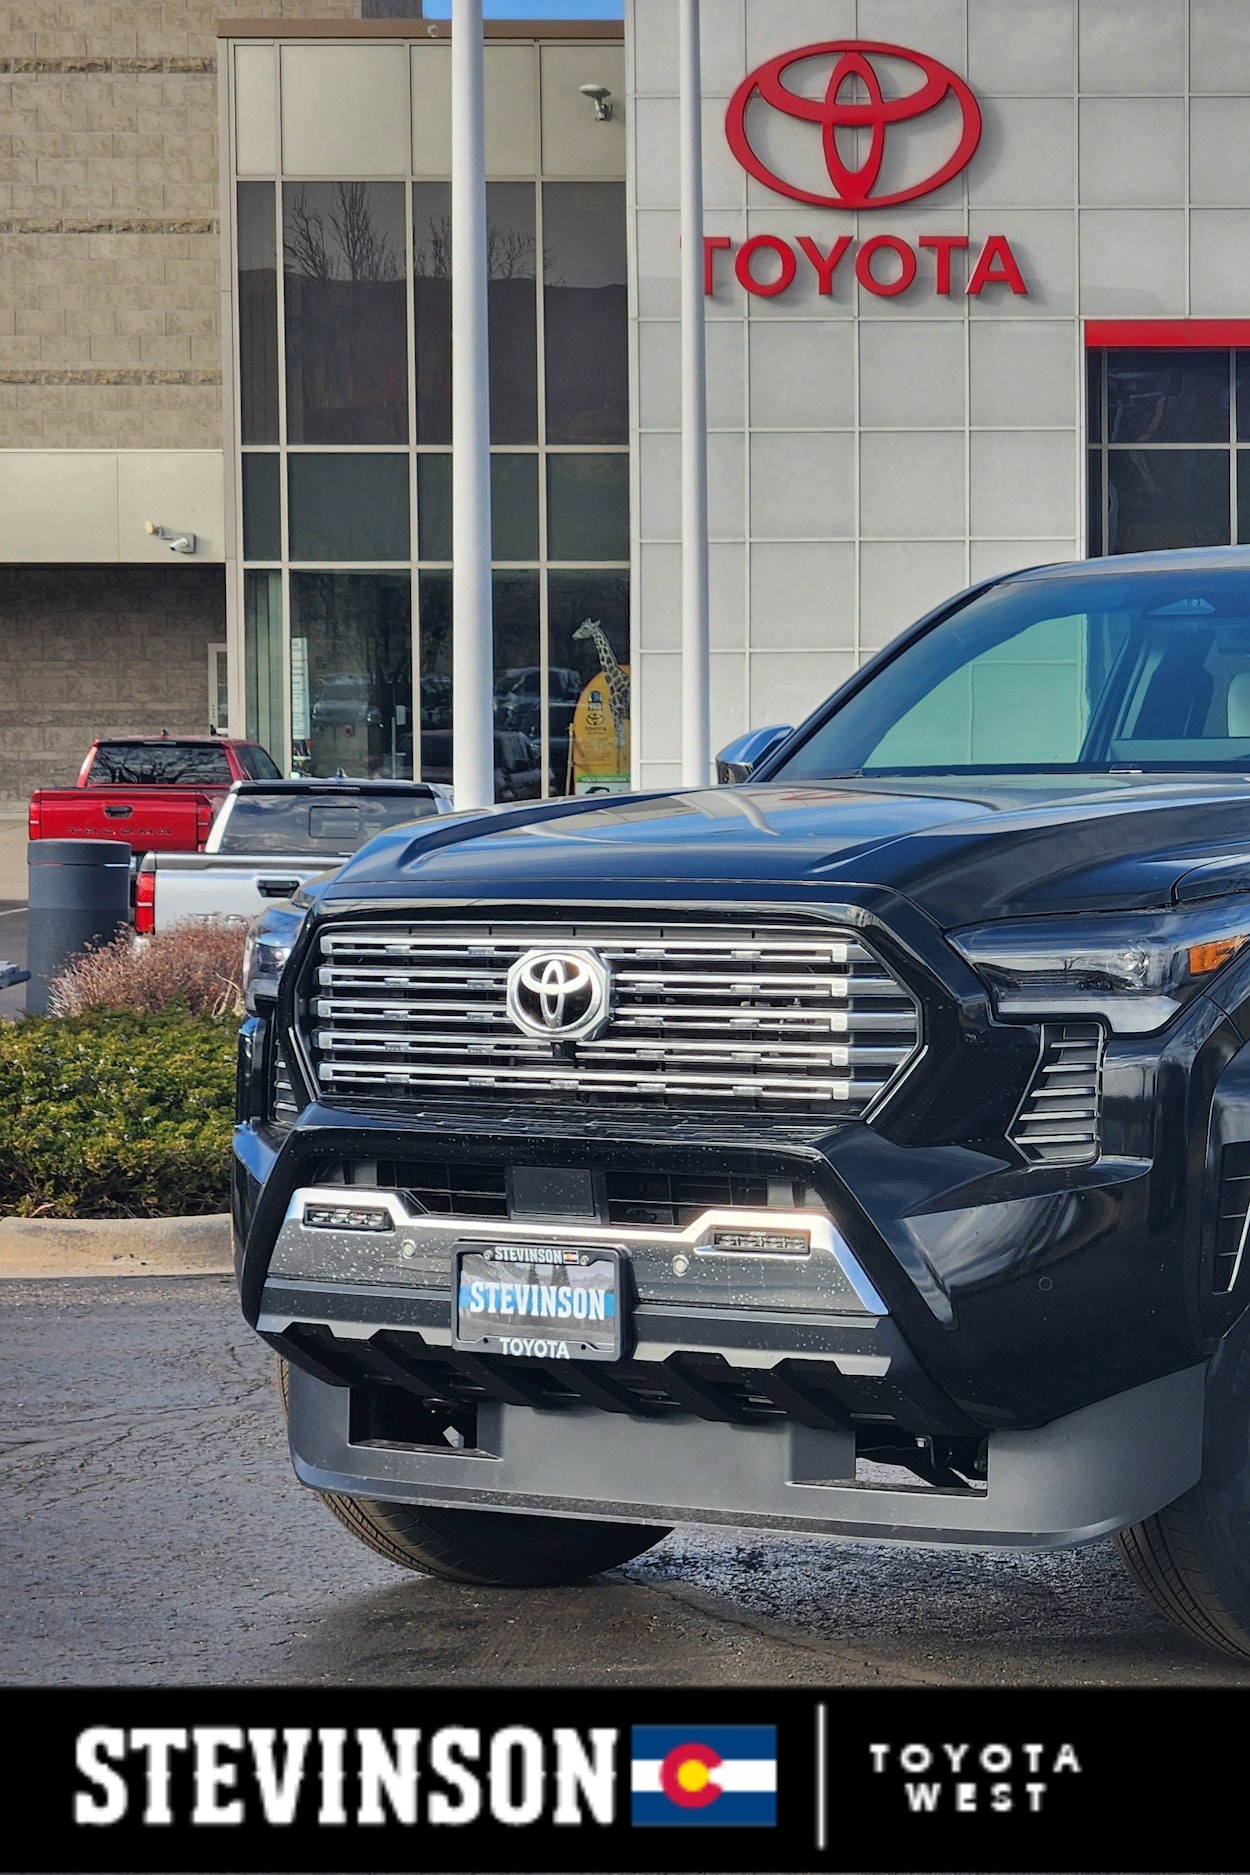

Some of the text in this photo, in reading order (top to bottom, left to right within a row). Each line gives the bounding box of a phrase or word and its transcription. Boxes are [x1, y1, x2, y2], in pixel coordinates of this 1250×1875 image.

[680, 235, 1028, 297] TOYOTA
[67, 828, 171, 836] TACOMA
[495, 1247, 562, 1264] STEVINSON
[470, 1282, 605, 1320] STEVINSON
[500, 1337, 570, 1359] TOYOTA
